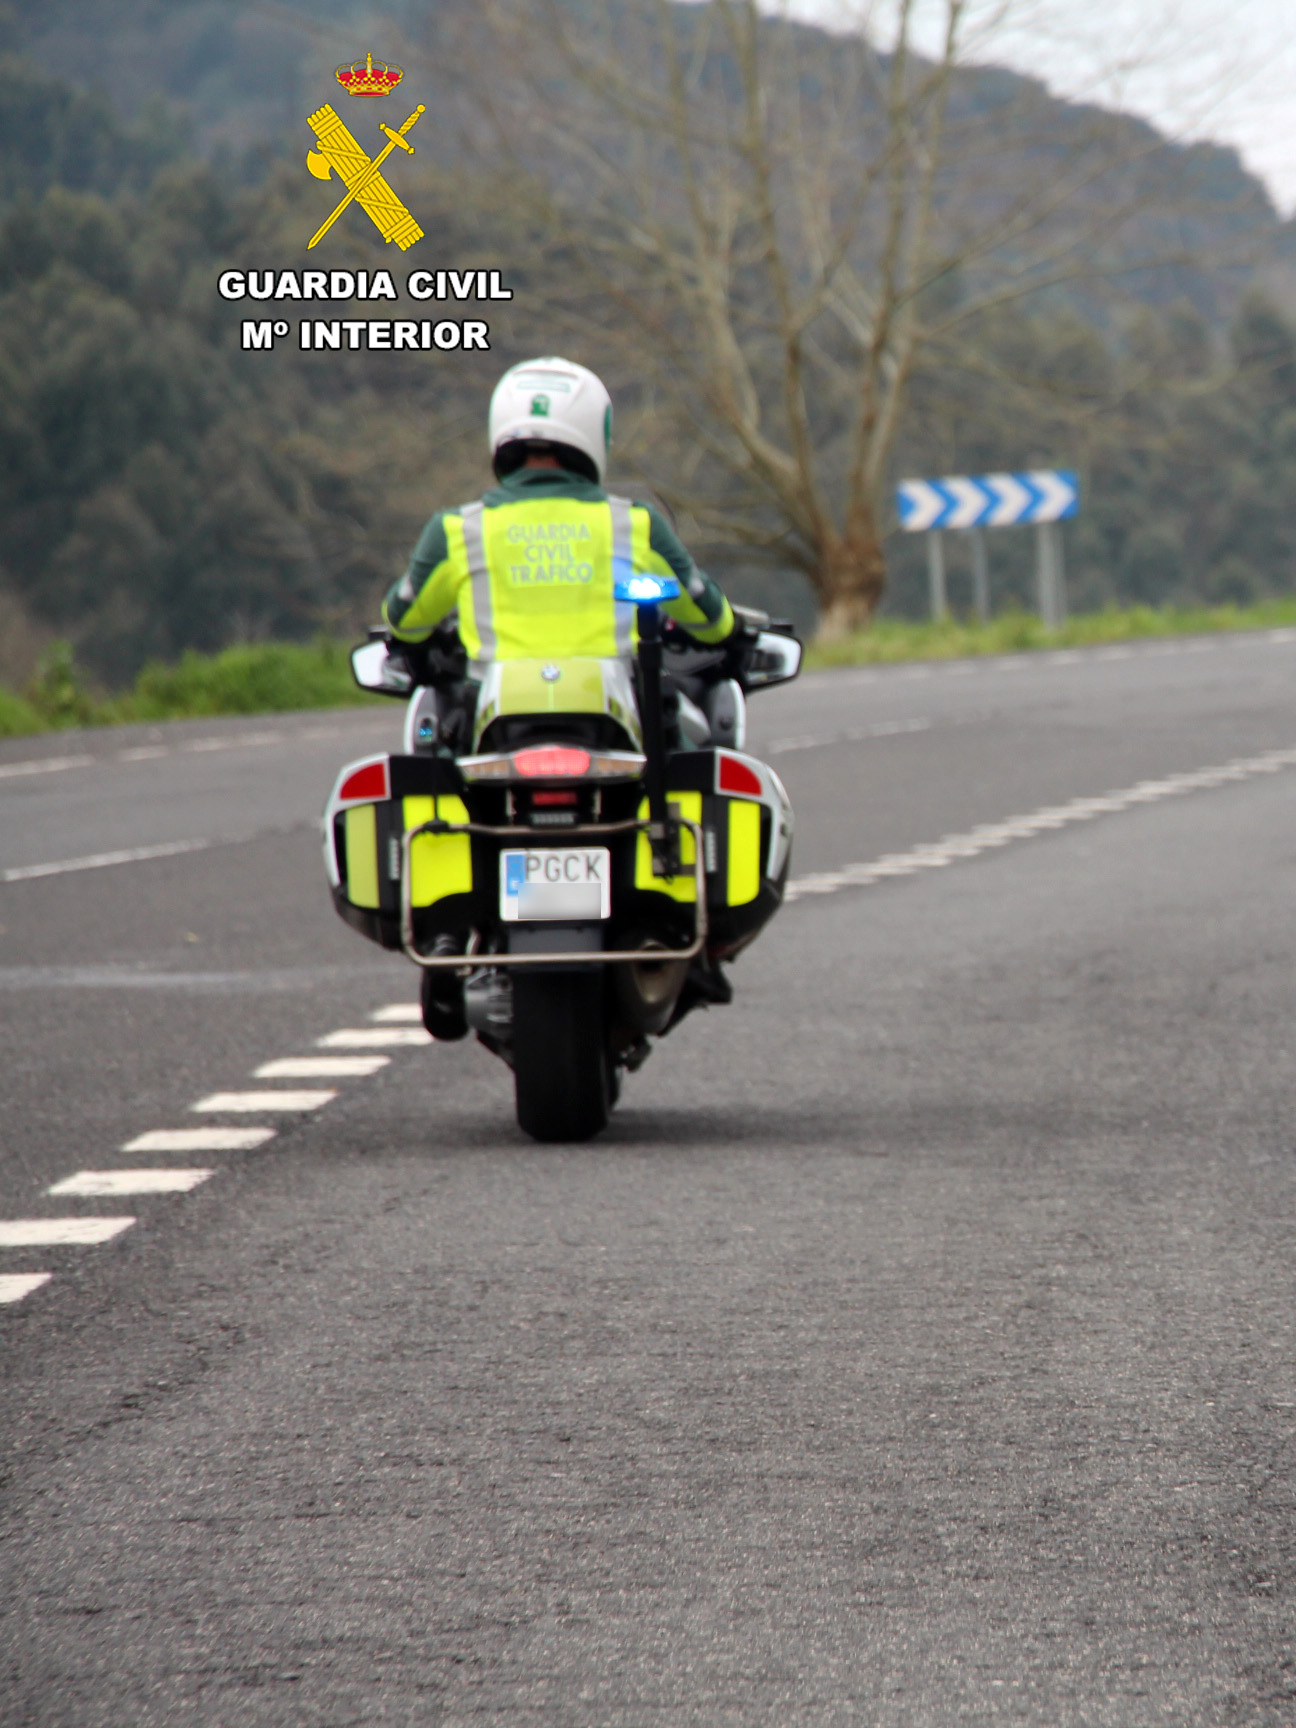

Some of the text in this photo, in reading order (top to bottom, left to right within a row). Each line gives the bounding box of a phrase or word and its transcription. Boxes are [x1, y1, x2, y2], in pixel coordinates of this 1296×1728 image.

[507, 523, 592, 543] GUARDIA
[525, 543, 574, 562] CIVIL
[525, 853, 601, 882] PGCK
